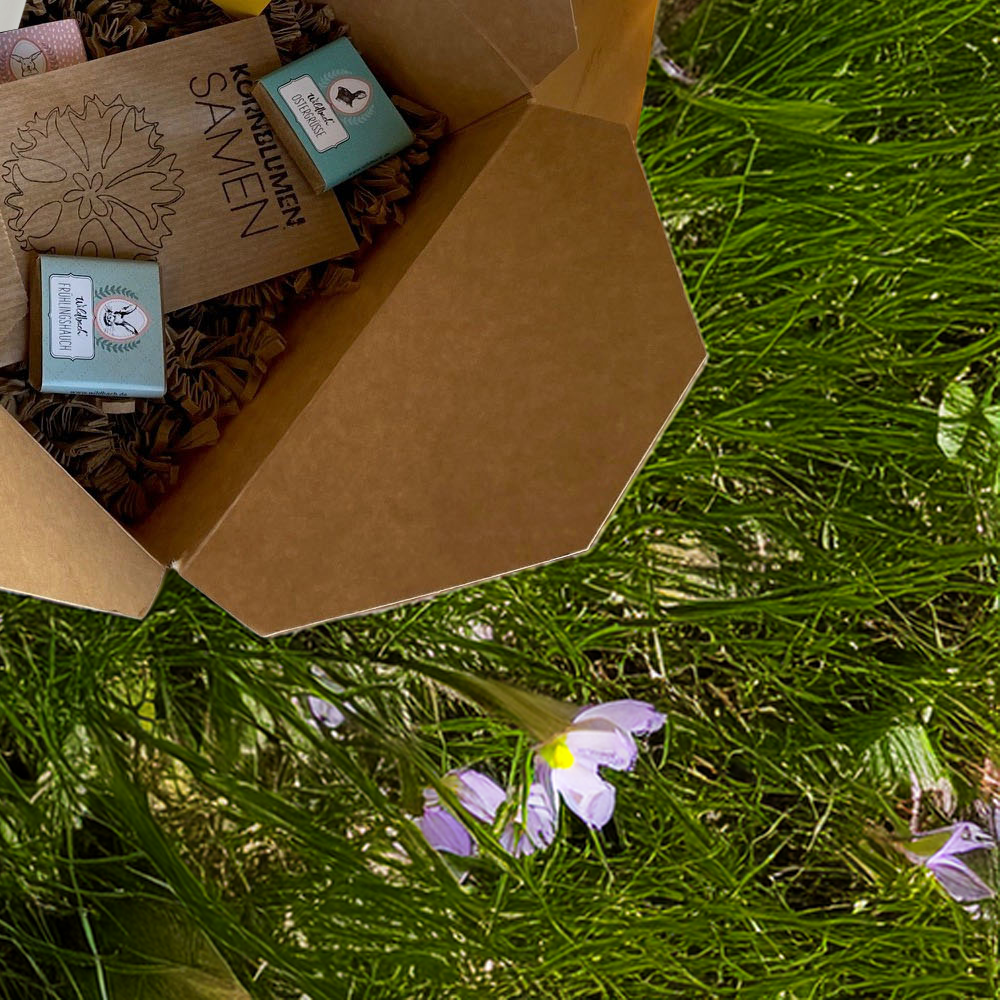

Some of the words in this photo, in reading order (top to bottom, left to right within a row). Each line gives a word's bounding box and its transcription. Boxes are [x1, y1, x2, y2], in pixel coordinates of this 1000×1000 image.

[291, 93, 327, 138] OSTERGRÜSSE
[189, 72, 279, 238] SAMEN
[58, 282, 72, 351] FRÜHLINGSHAUCH
